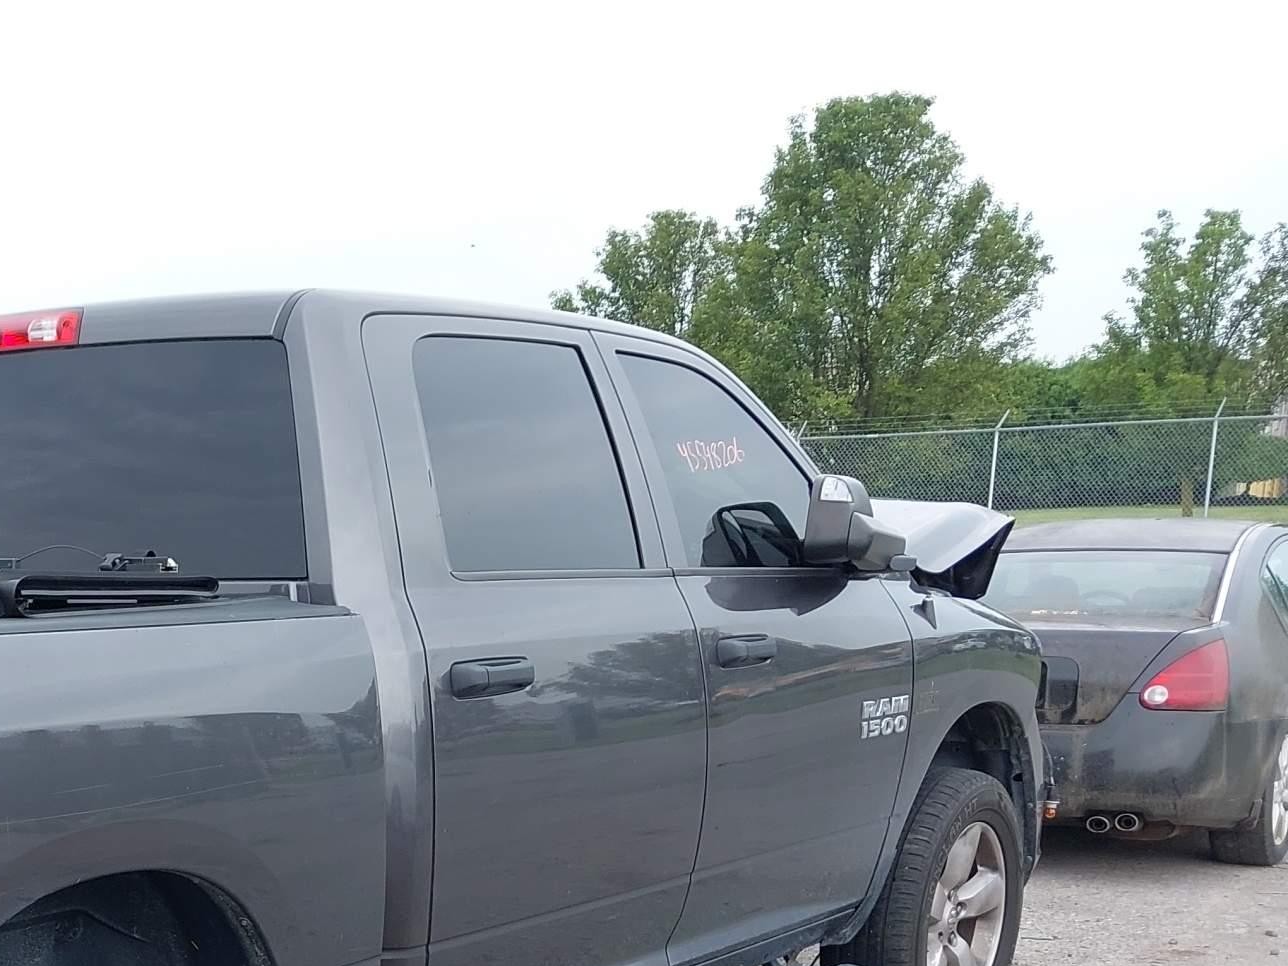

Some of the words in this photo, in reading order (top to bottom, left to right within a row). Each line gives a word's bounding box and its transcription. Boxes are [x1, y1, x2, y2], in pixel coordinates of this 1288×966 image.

[676, 436, 745, 473] 45548206
[862, 695, 909, 719] RAM
[860, 715, 908, 739] 1500
